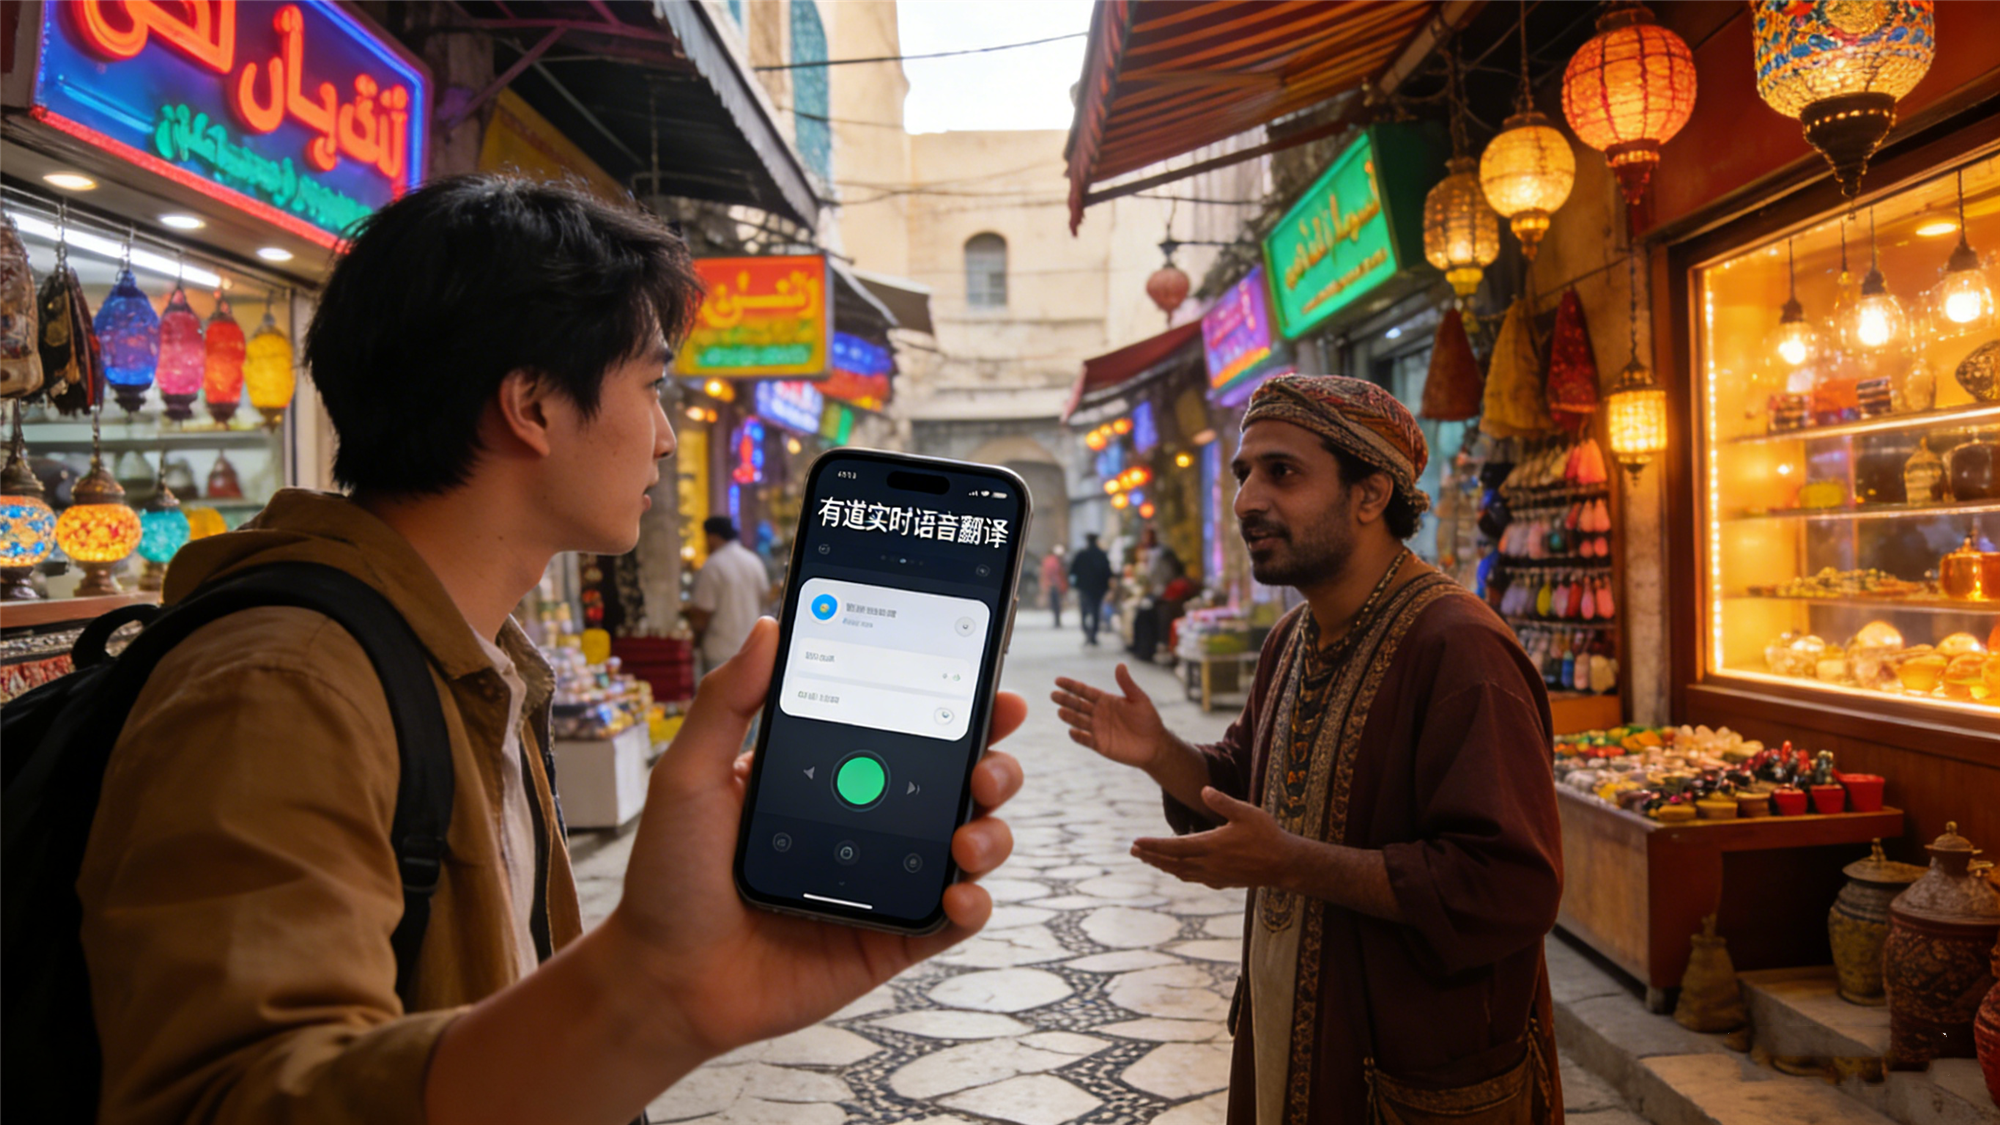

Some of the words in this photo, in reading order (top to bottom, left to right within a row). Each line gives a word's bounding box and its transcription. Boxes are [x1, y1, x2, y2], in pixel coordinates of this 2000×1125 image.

[817, 496, 1009, 548] 有道实时语音翻译
